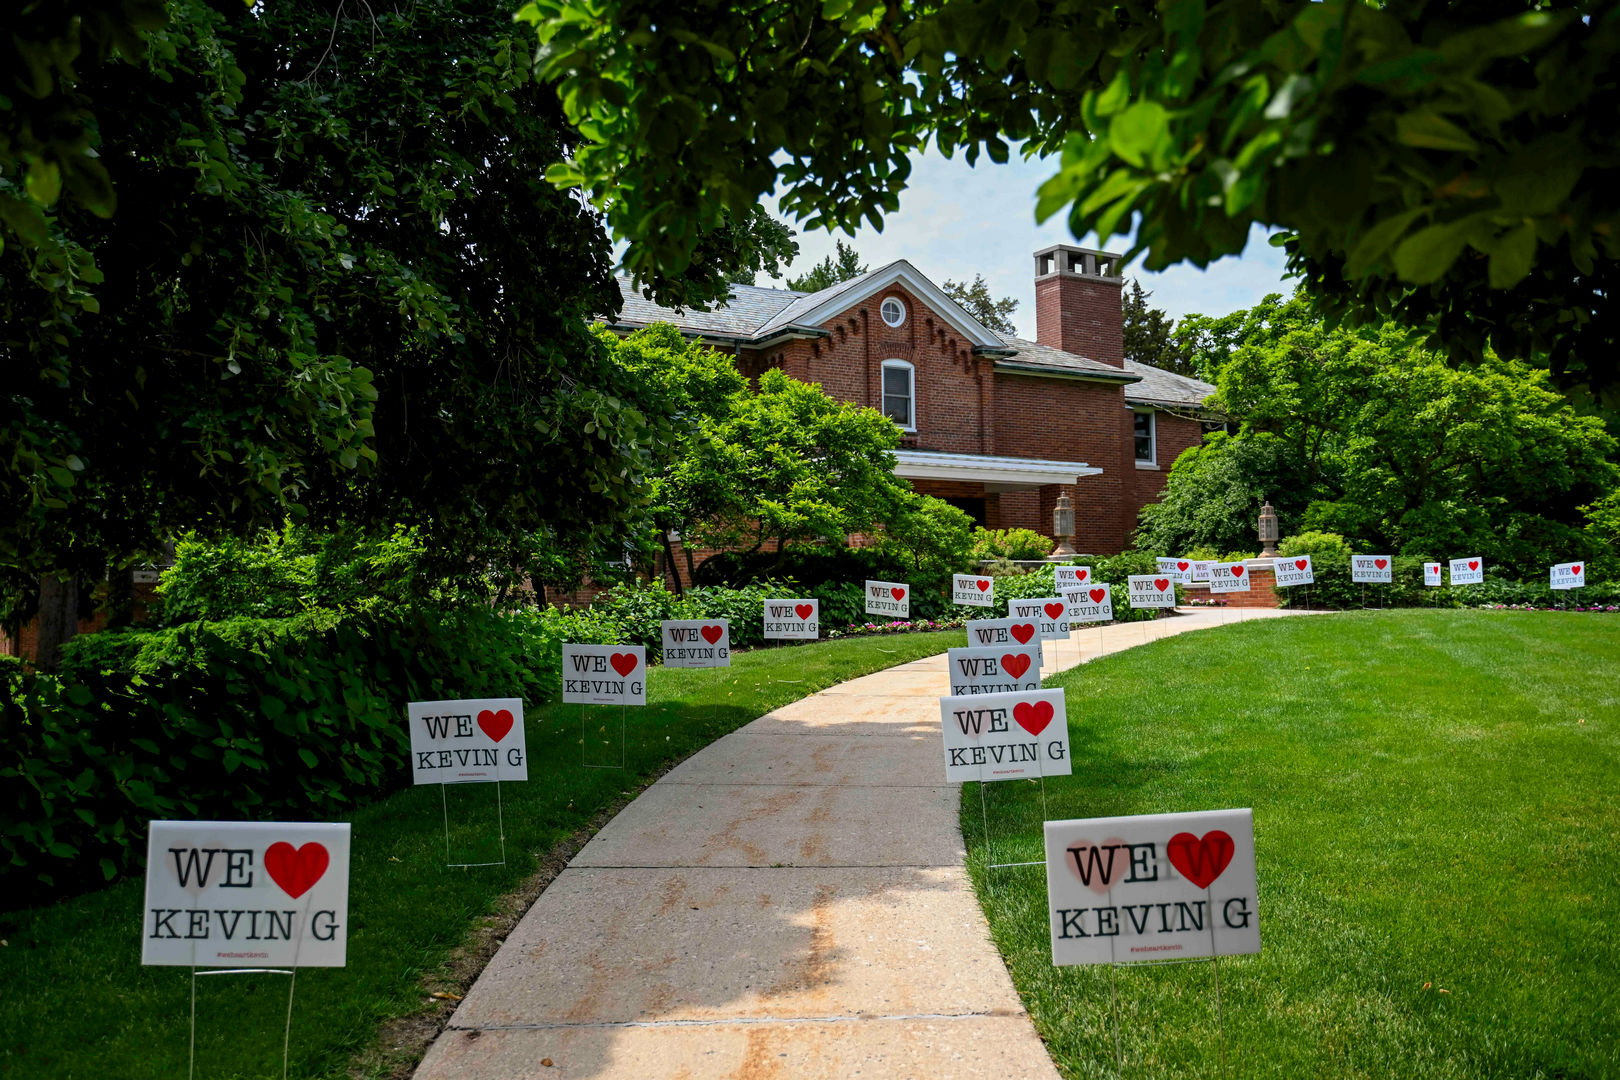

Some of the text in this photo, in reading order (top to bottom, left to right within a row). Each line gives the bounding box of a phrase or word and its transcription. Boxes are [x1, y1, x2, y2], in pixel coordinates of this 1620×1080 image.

[1160, 562, 1176, 570] WE
[1278, 562, 1294, 572] WE
[1356, 560, 1374, 568] WE
[1454, 563, 1468, 571] WE
[1058, 570, 1074, 579] WE
[1212, 568, 1230, 578] WE
[1277, 573, 1304, 582] KEVIN
[1354, 570, 1382, 578] KEVIN
[1452, 573, 1474, 581] KEVIN
[957, 579, 976, 590] WE
[1132, 580, 1153, 591] WE
[1211, 580, 1240, 589] KEVIN
[870, 586, 890, 598] WE
[954, 592, 992, 602] KEVIN G
[1066, 592, 1088, 603] WE
[1131, 594, 1165, 603] KEVIN
[867, 600, 908, 612] KEVIN G
[1016, 606, 1042, 617] WE
[1102, 605, 1110, 614] G
[770, 606, 793, 618] WE
[766, 622, 817, 632] KEVIN G
[1060, 622, 1068, 632] G
[669, 628, 698, 642] WE
[976, 628, 1008, 644] WE
[666, 648, 728, 659] KEVIN G
[570, 654, 606, 672] WE
[958, 658, 997, 677] WE
[565, 680, 643, 695] KEVIN G
[422, 714, 473, 739] WE
[954, 708, 1008, 735] WE
[416, 748, 523, 769] KEVIN G
[949, 741, 1066, 766] KEVIN G
[168, 848, 254, 888] WE
[1066, 842, 1158, 886] WE
[1056, 897, 1252, 939] KEVIN G
[149, 909, 340, 941] KEVIN G
